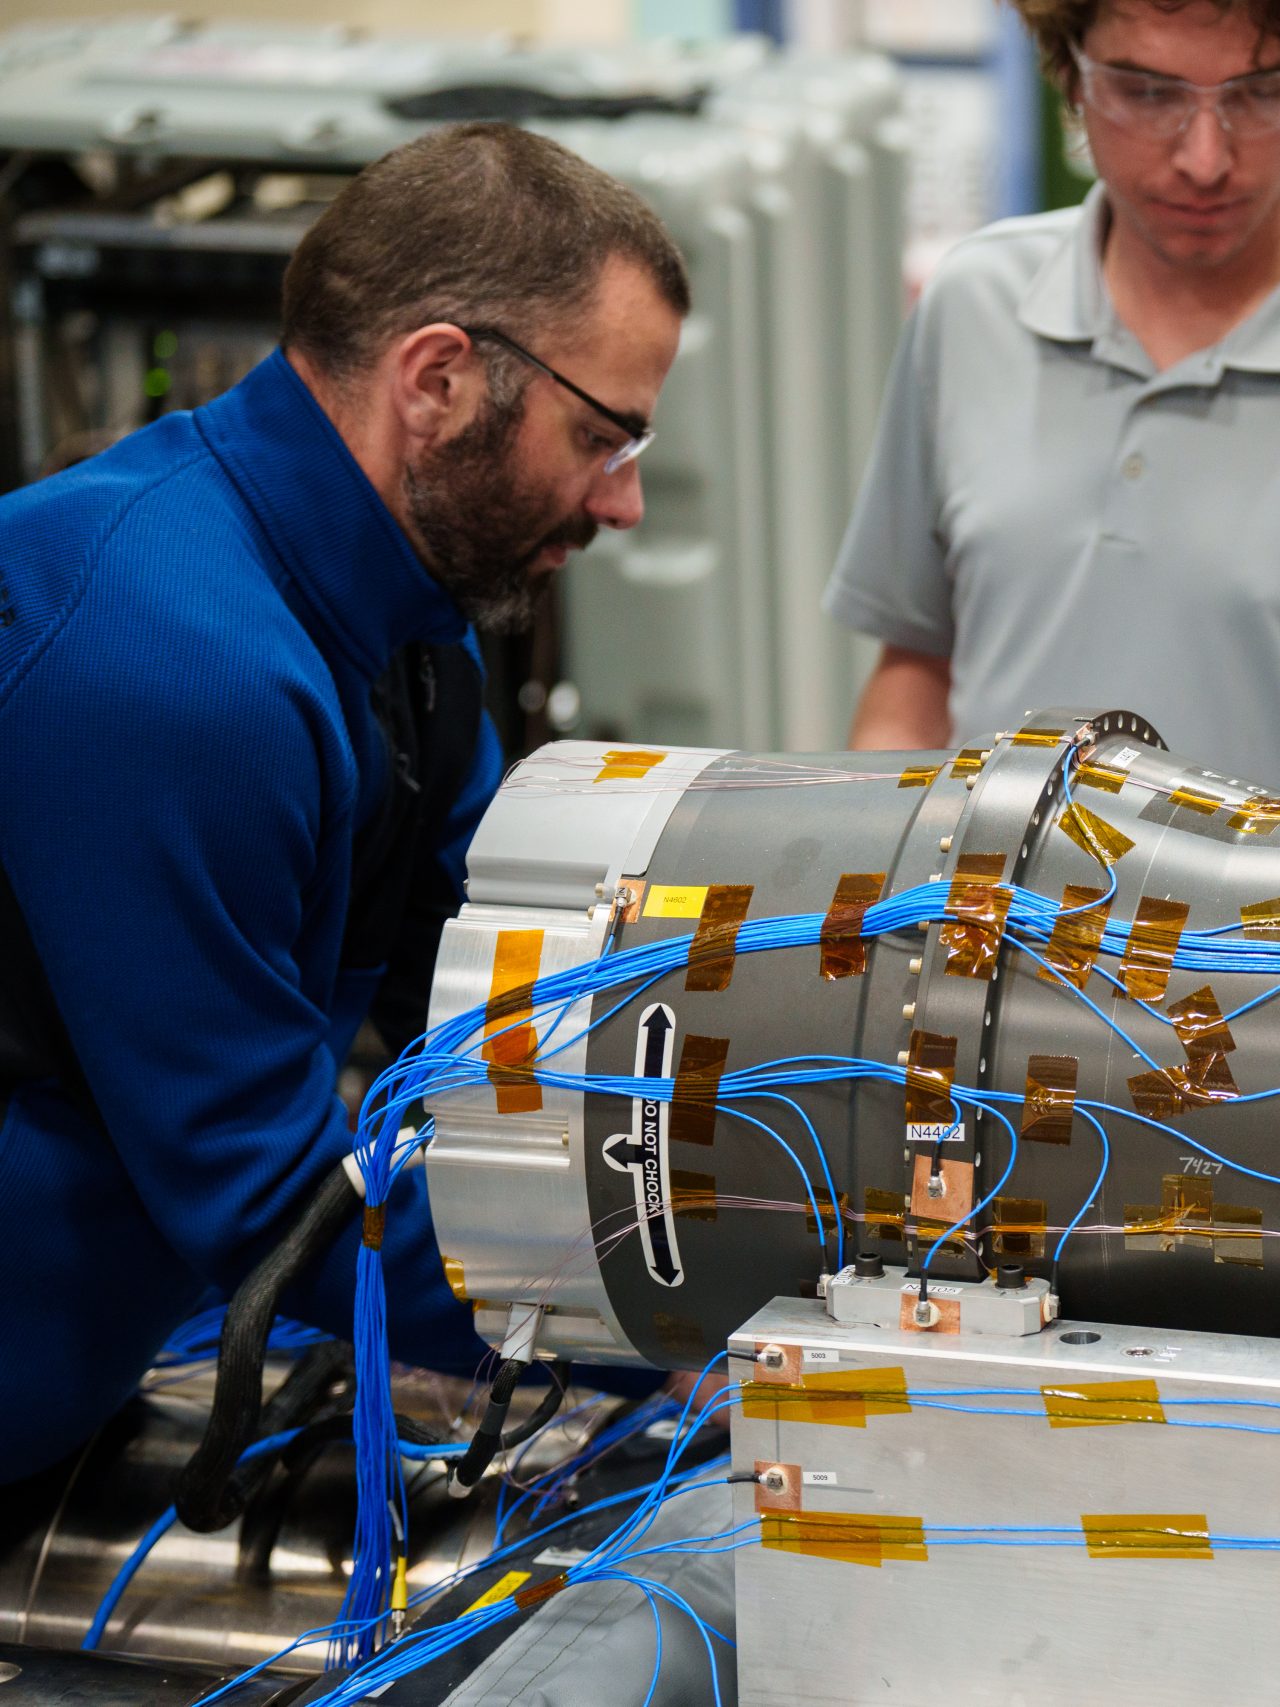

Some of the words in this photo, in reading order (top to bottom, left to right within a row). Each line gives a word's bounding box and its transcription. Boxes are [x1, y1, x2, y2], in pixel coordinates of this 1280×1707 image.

[644, 1121, 658, 1156] NOT
[1179, 1156, 1223, 1175] 7427
[645, 1159, 661, 1216] CHOCK
[906, 1284, 957, 1294] N105
